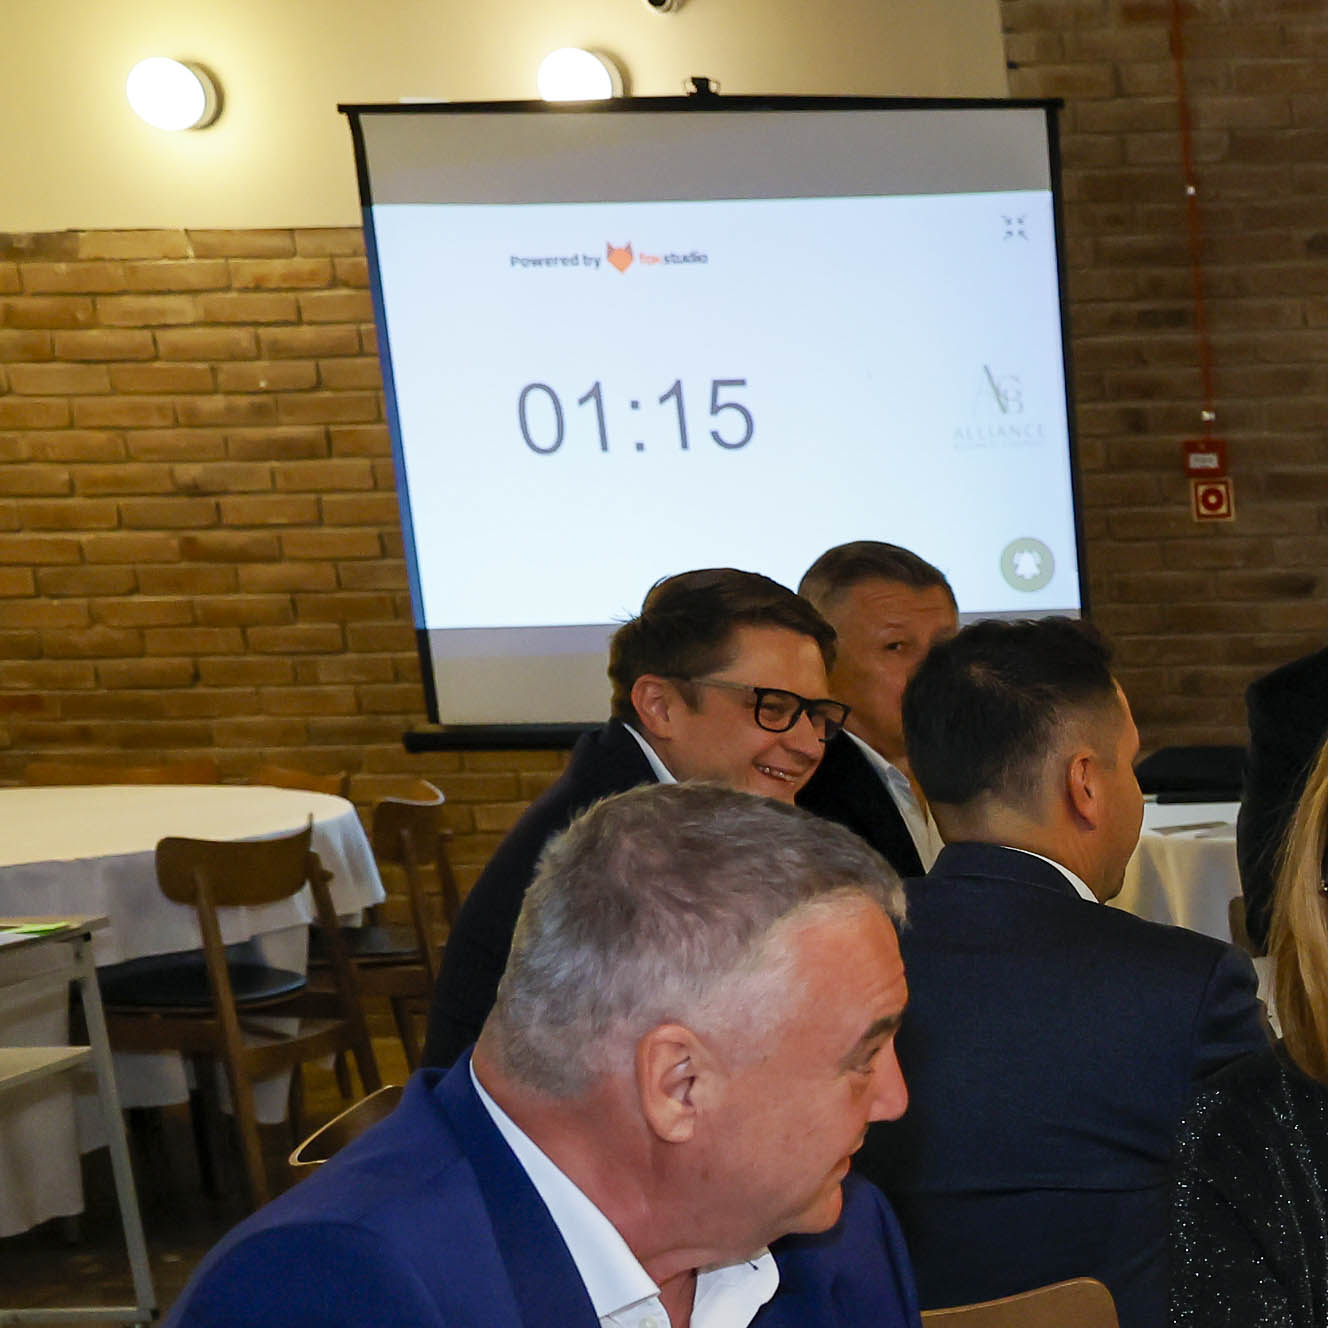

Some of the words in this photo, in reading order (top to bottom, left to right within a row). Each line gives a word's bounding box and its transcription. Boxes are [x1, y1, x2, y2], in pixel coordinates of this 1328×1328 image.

[510, 253, 579, 267] Powered
[583, 254, 601, 270] by
[518, 377, 755, 455] 01:15
